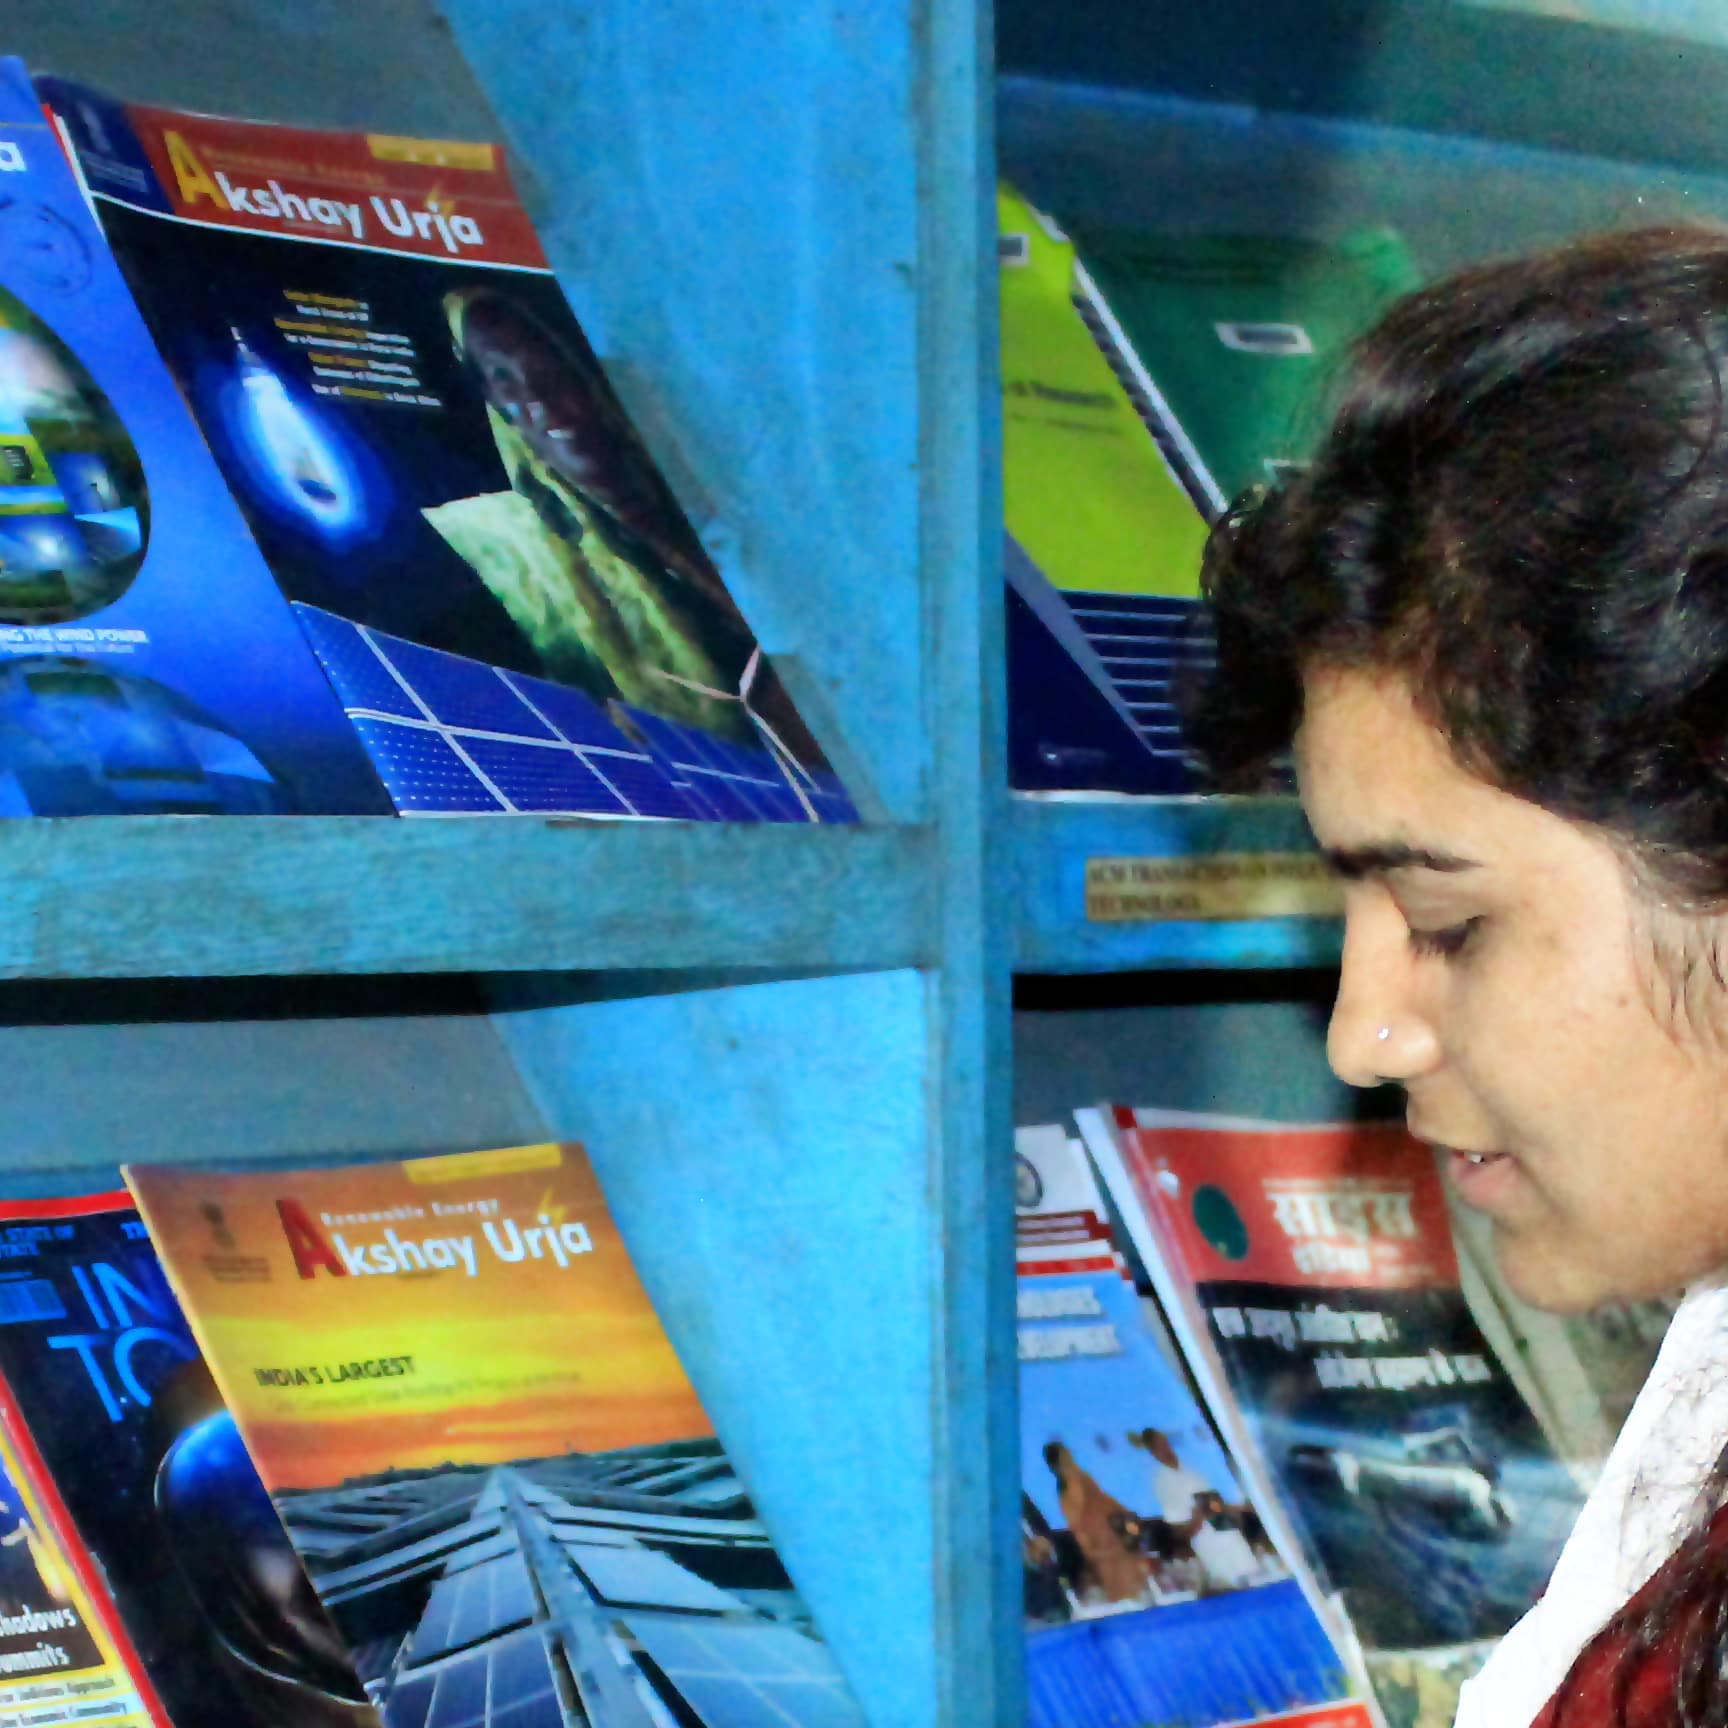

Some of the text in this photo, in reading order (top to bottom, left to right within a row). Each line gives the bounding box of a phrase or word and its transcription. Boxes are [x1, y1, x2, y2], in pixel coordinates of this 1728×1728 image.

[165, 130, 364, 239] Akshay
[370, 194, 484, 253] Urja
[276, 1198, 594, 1279] Akshay Urja
[253, 1355, 417, 1388] INDIA'S LARGEST
